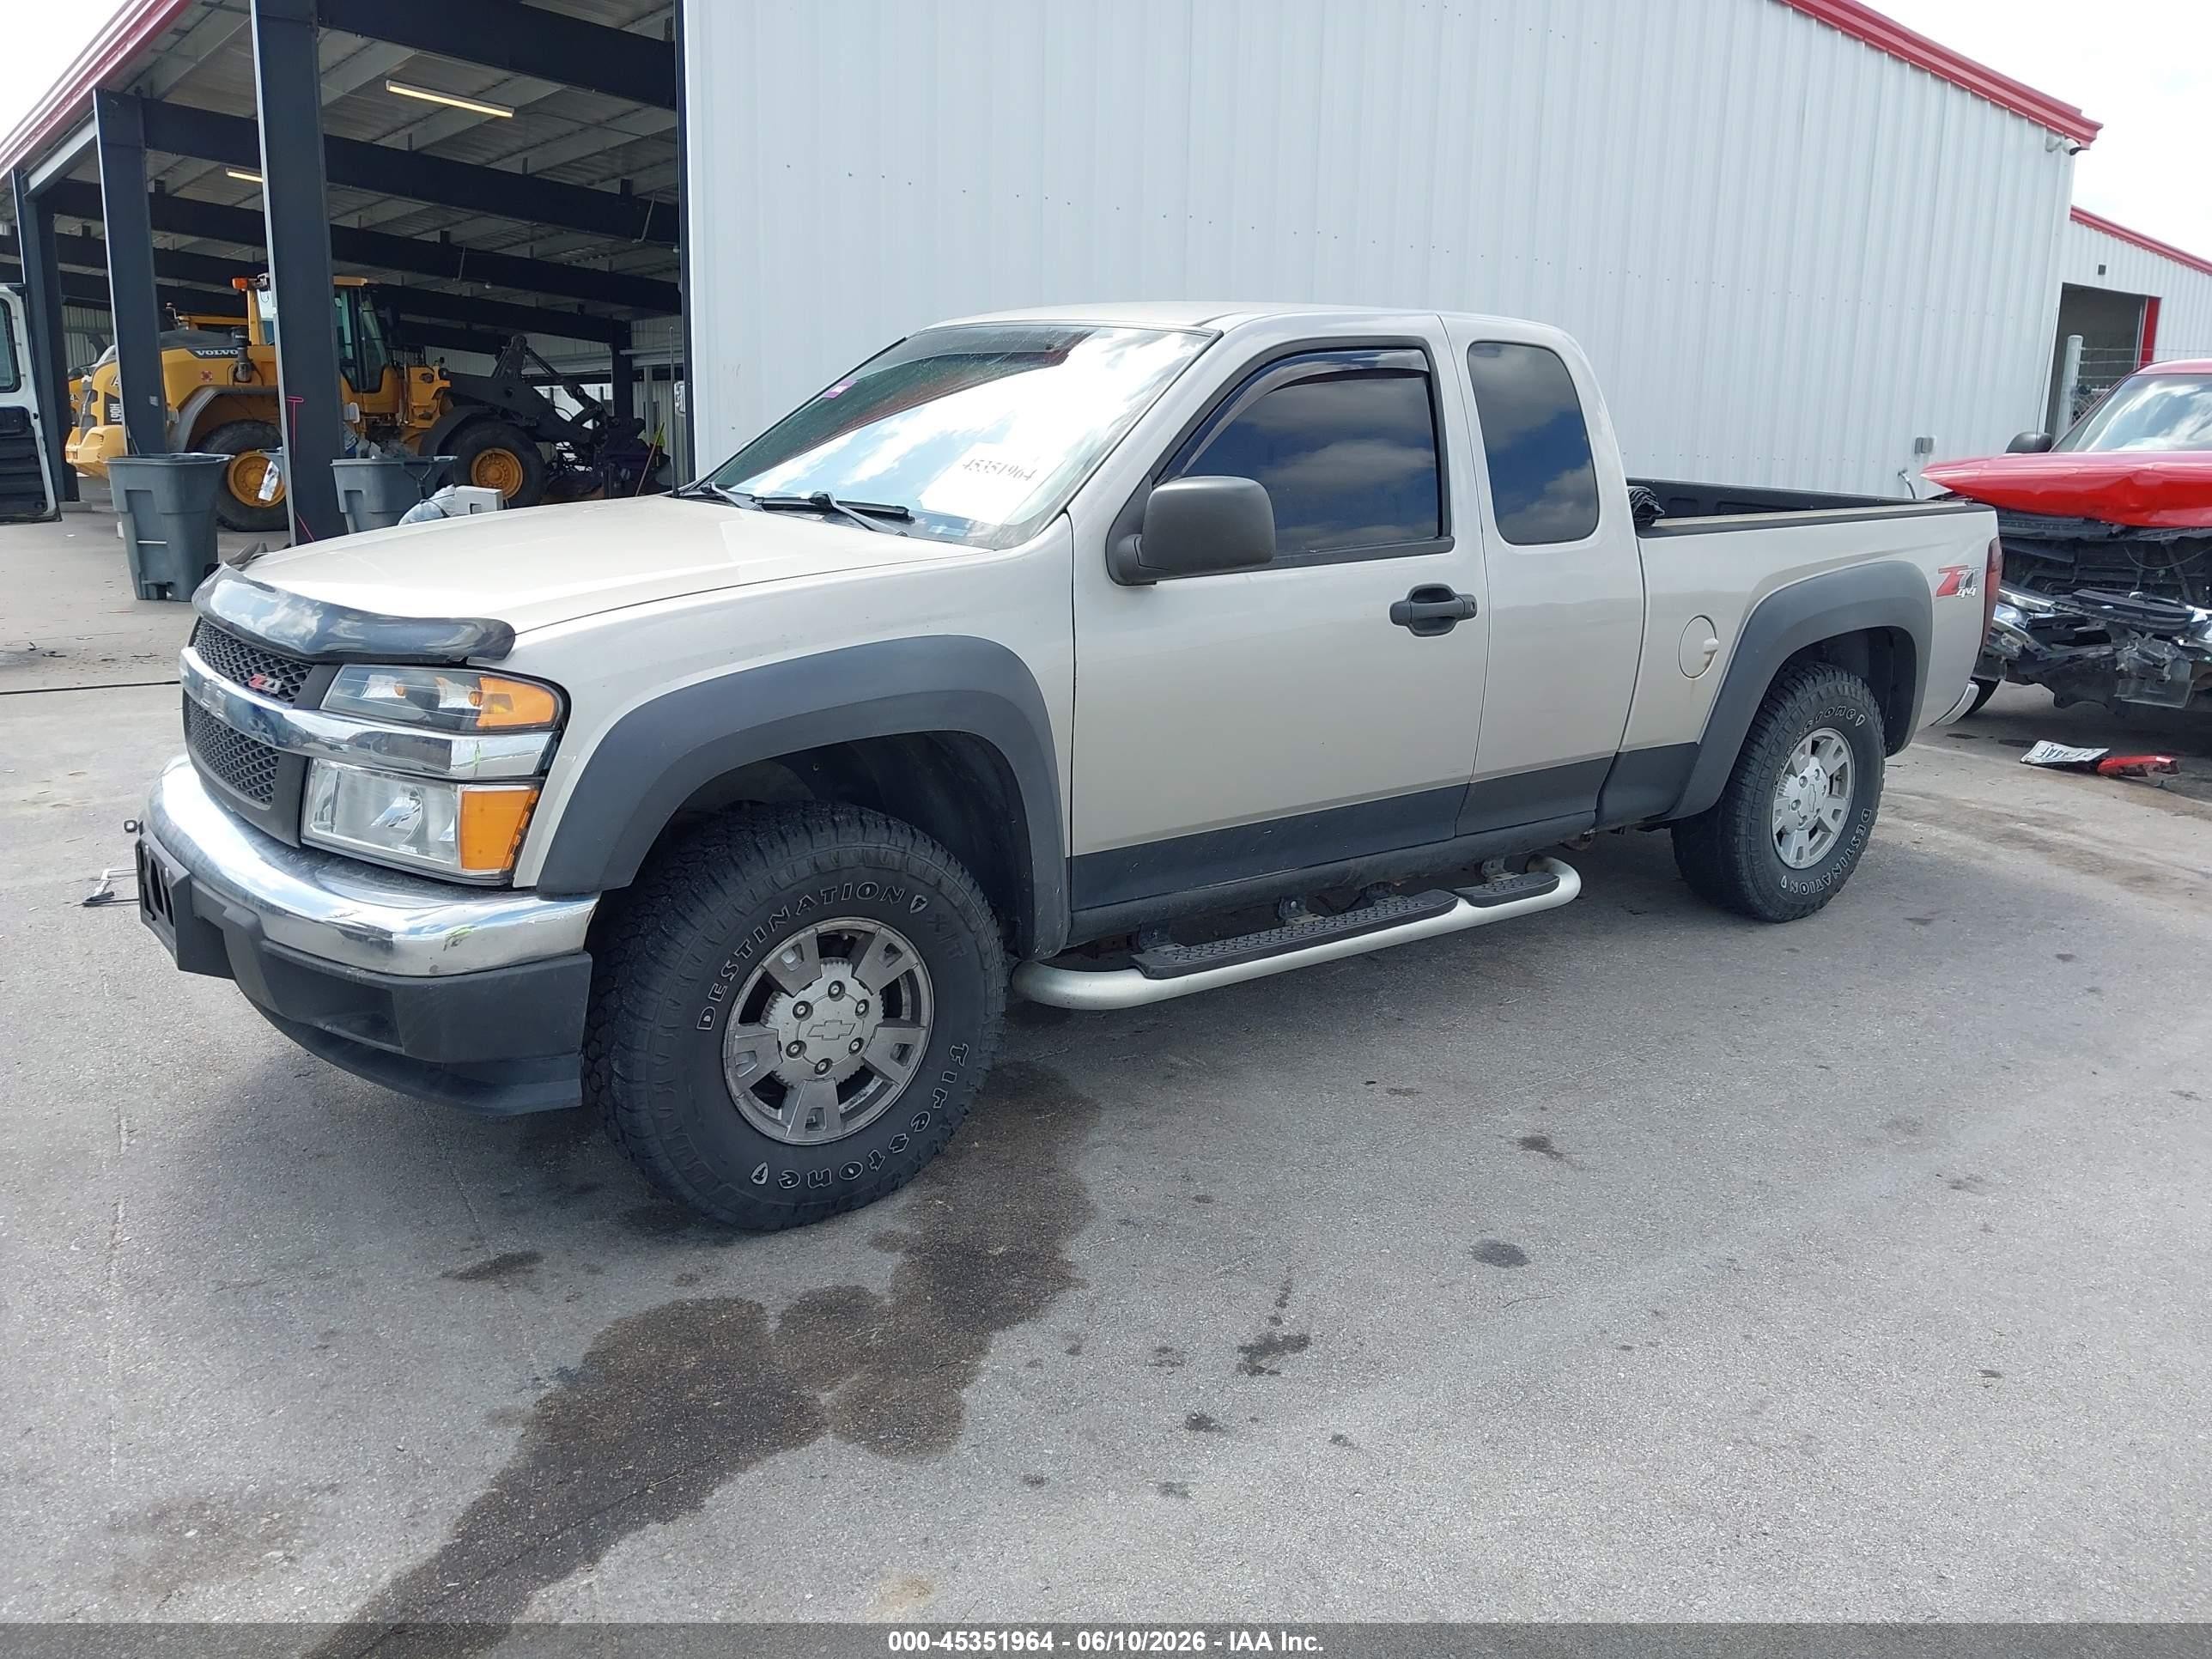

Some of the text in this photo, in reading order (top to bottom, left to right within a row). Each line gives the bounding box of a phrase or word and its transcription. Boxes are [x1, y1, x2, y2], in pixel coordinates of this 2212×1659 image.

[1936, 564, 1981, 597] Z71
[696, 880, 906, 1030] DESTINATION
[778, 1042, 970, 1191] Firestone
